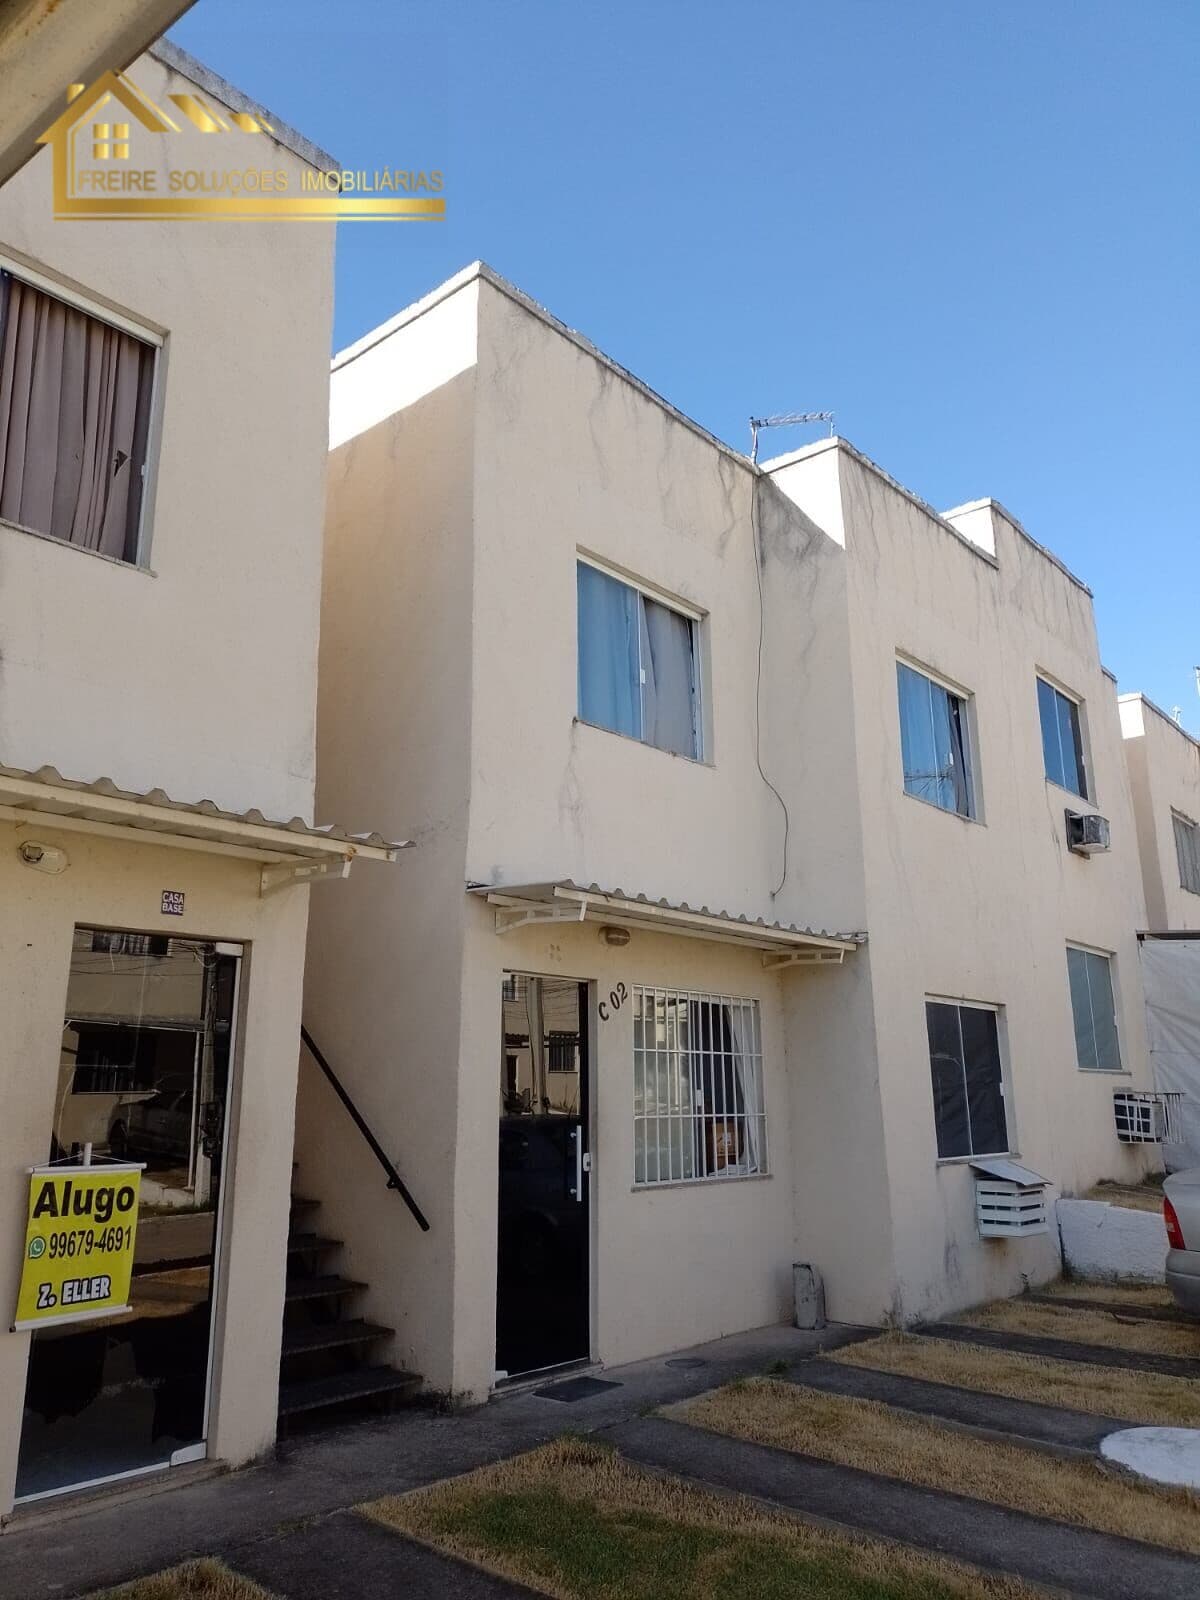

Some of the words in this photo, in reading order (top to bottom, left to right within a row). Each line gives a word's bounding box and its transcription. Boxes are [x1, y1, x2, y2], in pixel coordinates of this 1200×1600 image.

[162, 891, 184, 904] CASA
[162, 902, 184, 914] BASE
[598, 1001, 610, 1021] C
[609, 981, 628, 1010] 02
[32, 1180, 135, 1223] Alugo
[48, 1225, 132, 1259] 99679-4691
[37, 1283, 57, 1309] Z.
[60, 1275, 111, 1305] ELLER
